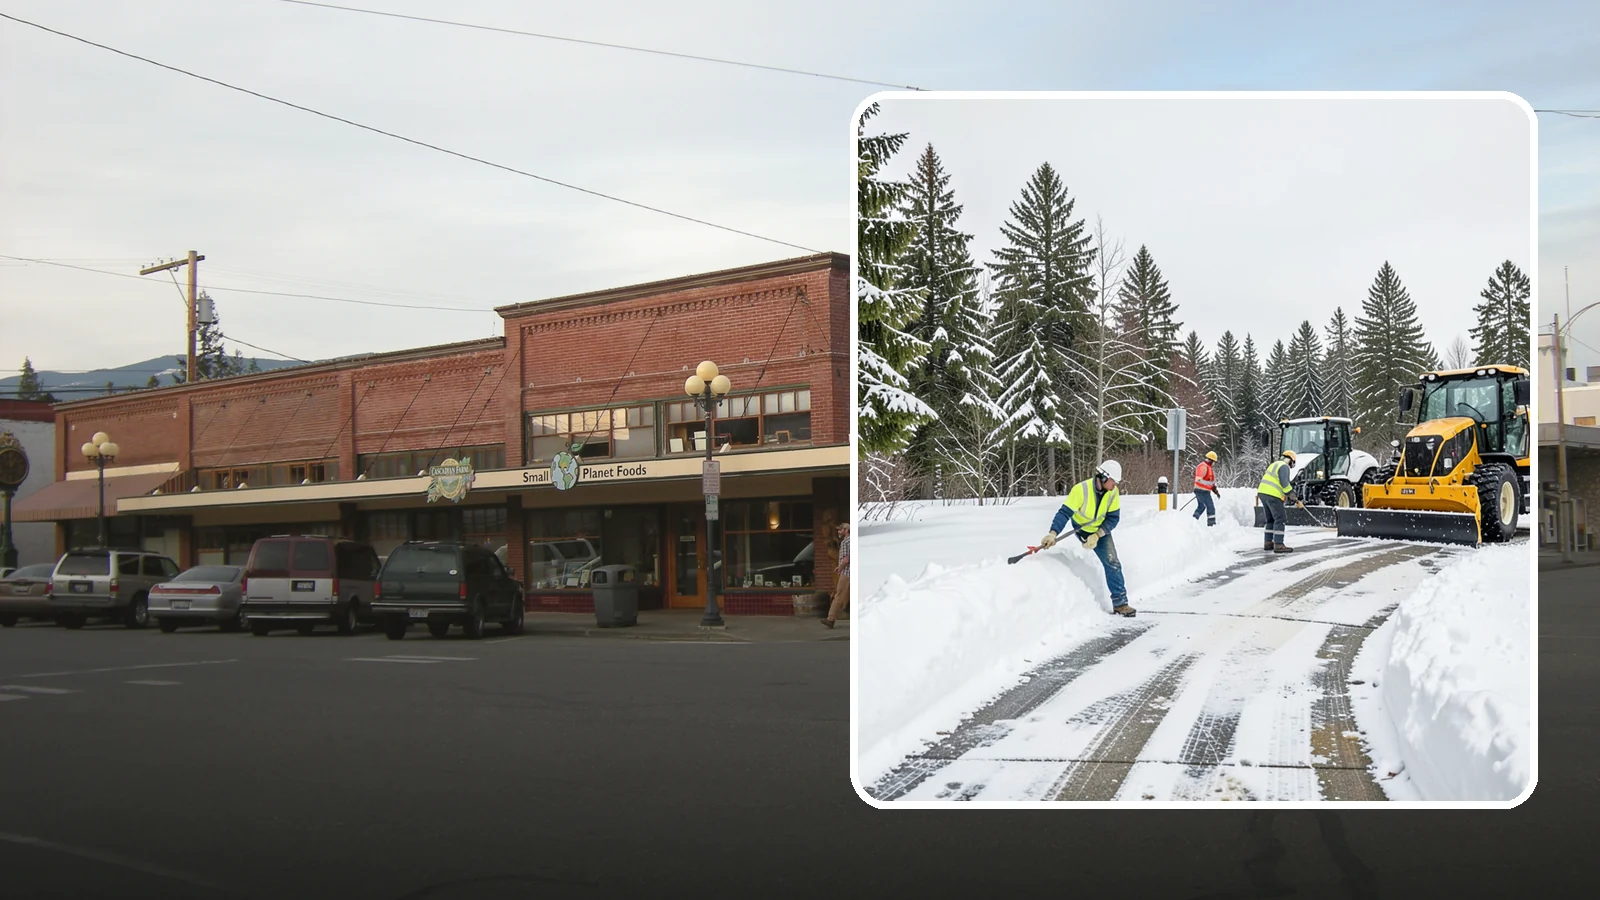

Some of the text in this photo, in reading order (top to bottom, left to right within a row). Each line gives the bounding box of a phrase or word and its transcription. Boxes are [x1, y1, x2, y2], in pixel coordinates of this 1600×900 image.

[523, 464, 647, 483] Small Planet Foods
